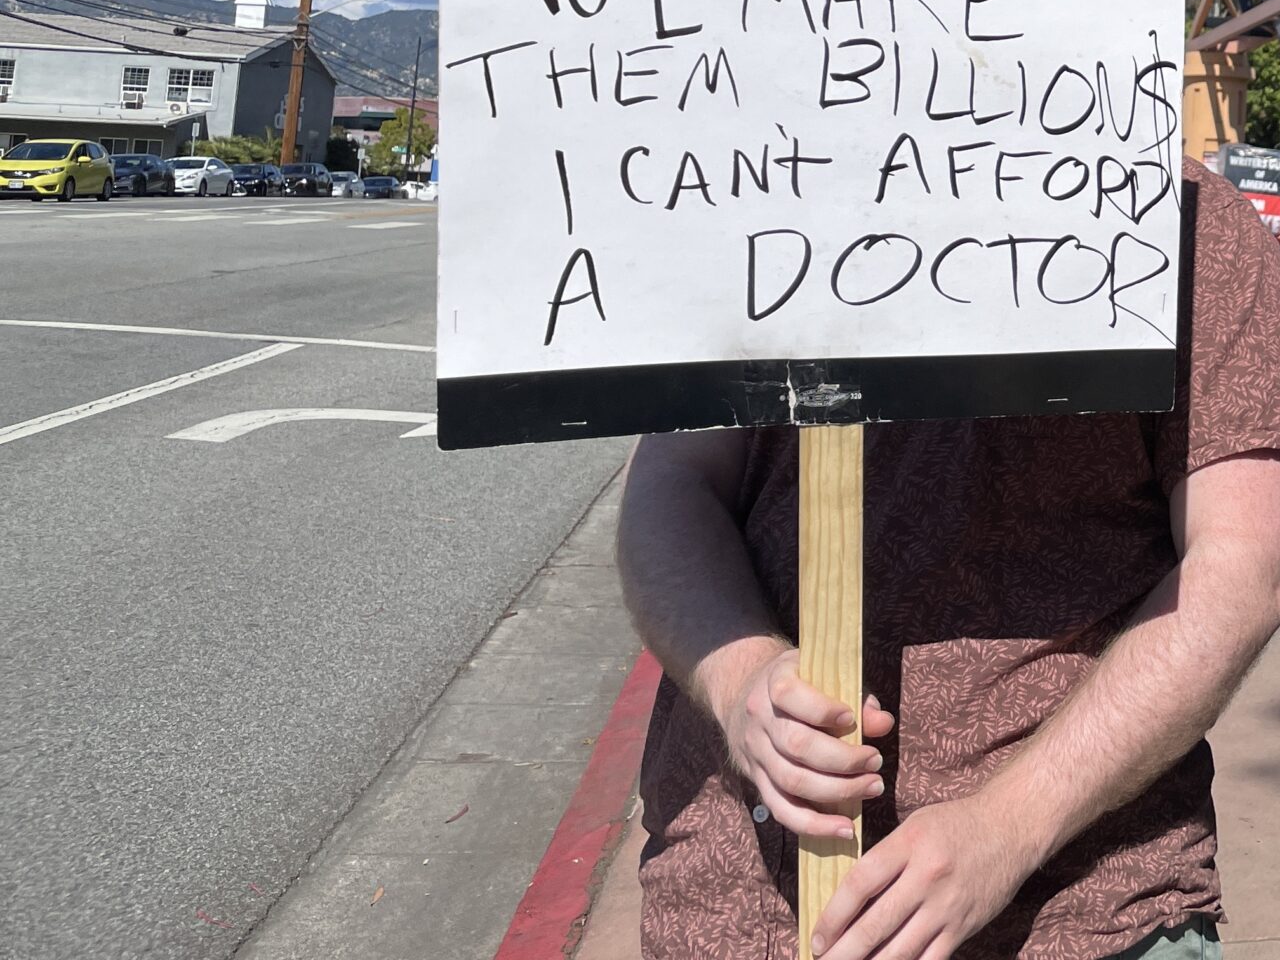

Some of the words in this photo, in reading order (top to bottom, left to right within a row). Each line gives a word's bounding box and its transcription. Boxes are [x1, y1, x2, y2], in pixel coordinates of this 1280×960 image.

[446, 40, 740, 118] THEM
[555, 148, 573, 236] I
[875, 132, 1173, 225] AFFORD
[1229, 155, 1267, 170] WRITERS
[1239, 178, 1278, 192] AMERICA
[1254, 169, 1265, 179] OF
[543, 247, 607, 347] A
[746, 228, 1178, 348] DOCTOR
